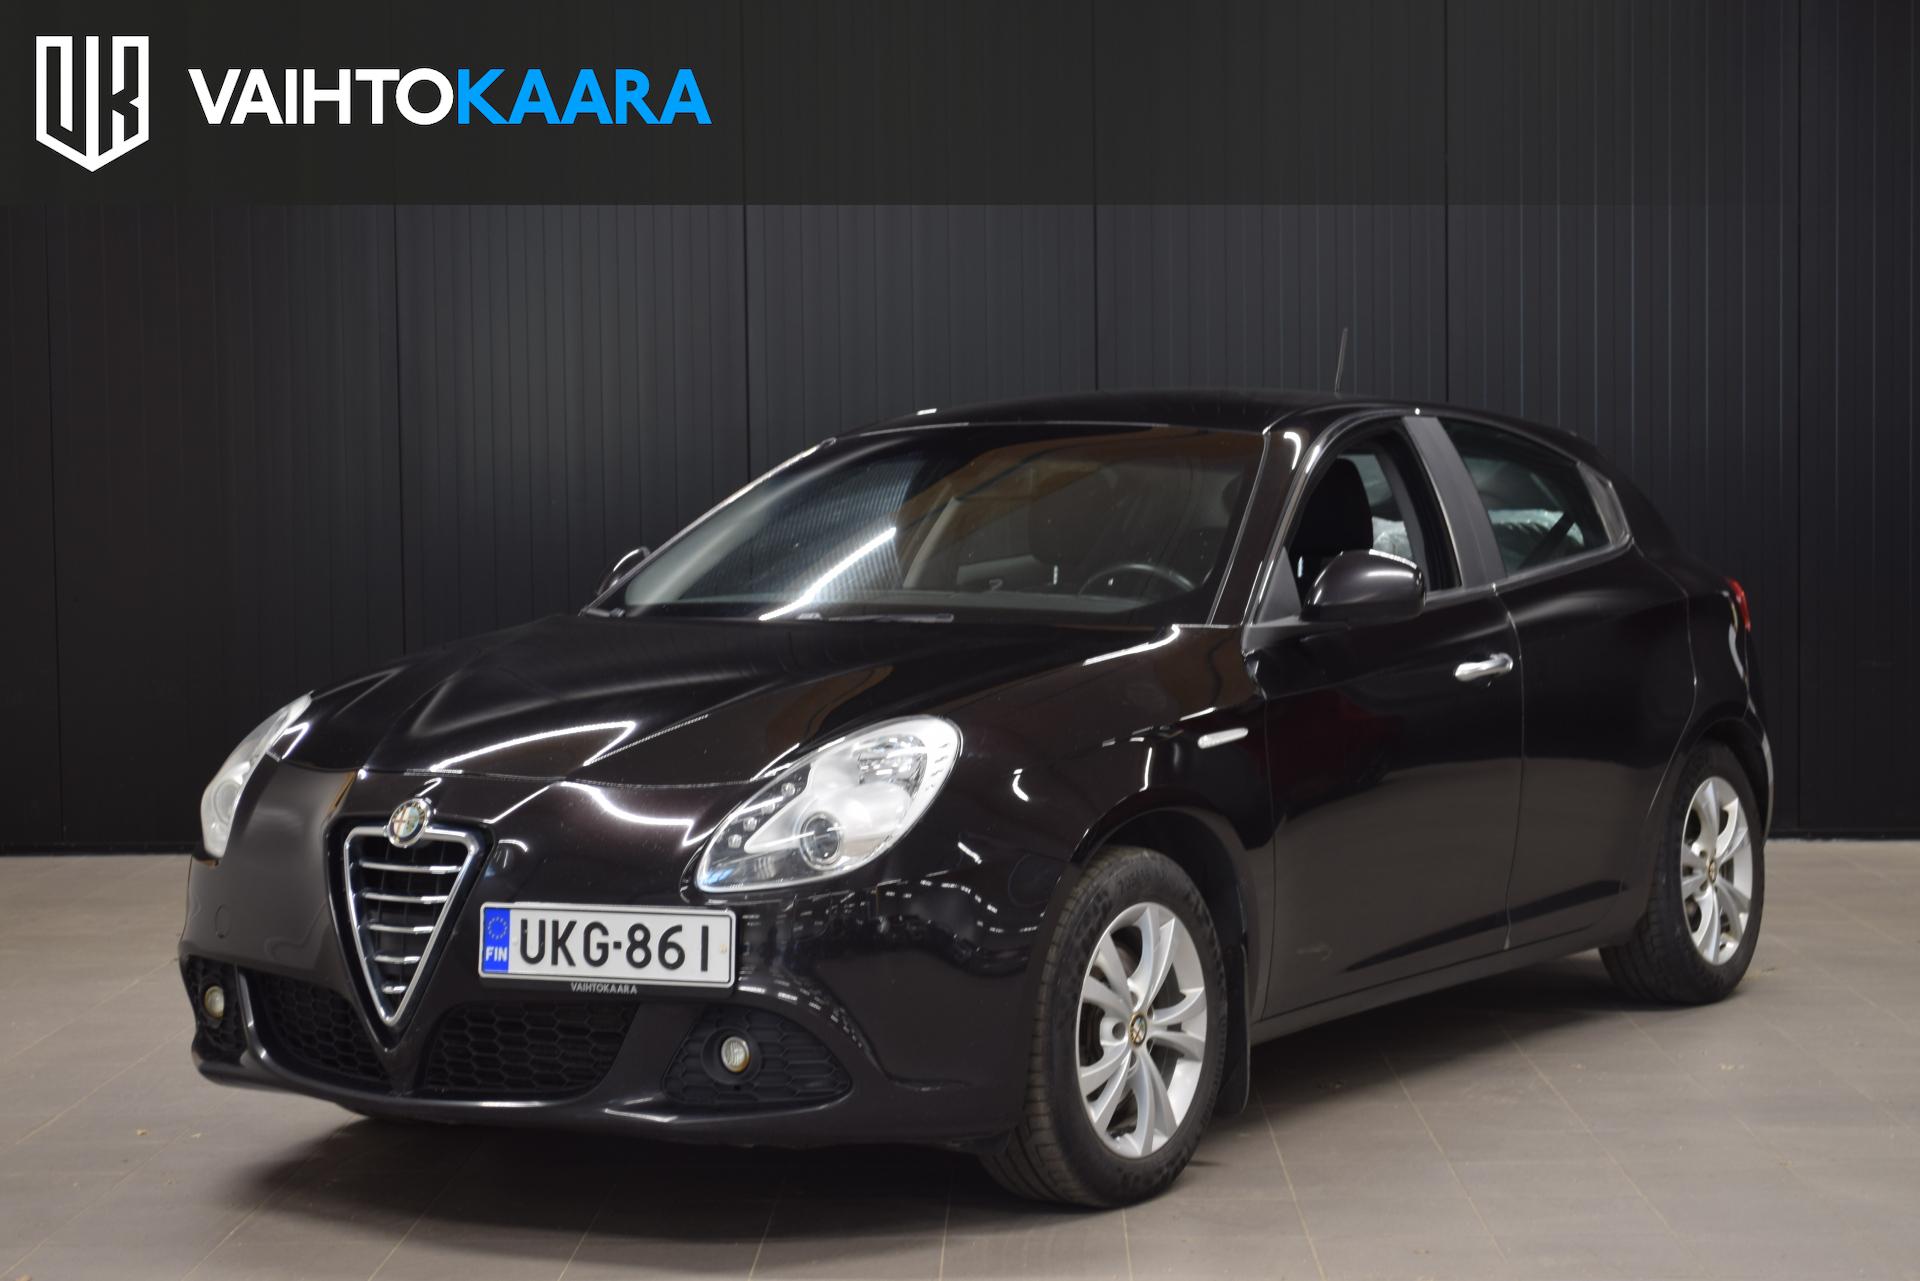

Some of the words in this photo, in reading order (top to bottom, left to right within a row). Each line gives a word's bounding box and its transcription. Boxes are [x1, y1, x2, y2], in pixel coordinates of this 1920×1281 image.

[519, 918, 709, 972] UKG-861
[485, 946, 508, 962] FIN
[570, 982, 638, 994] VAIHTOKAARA
